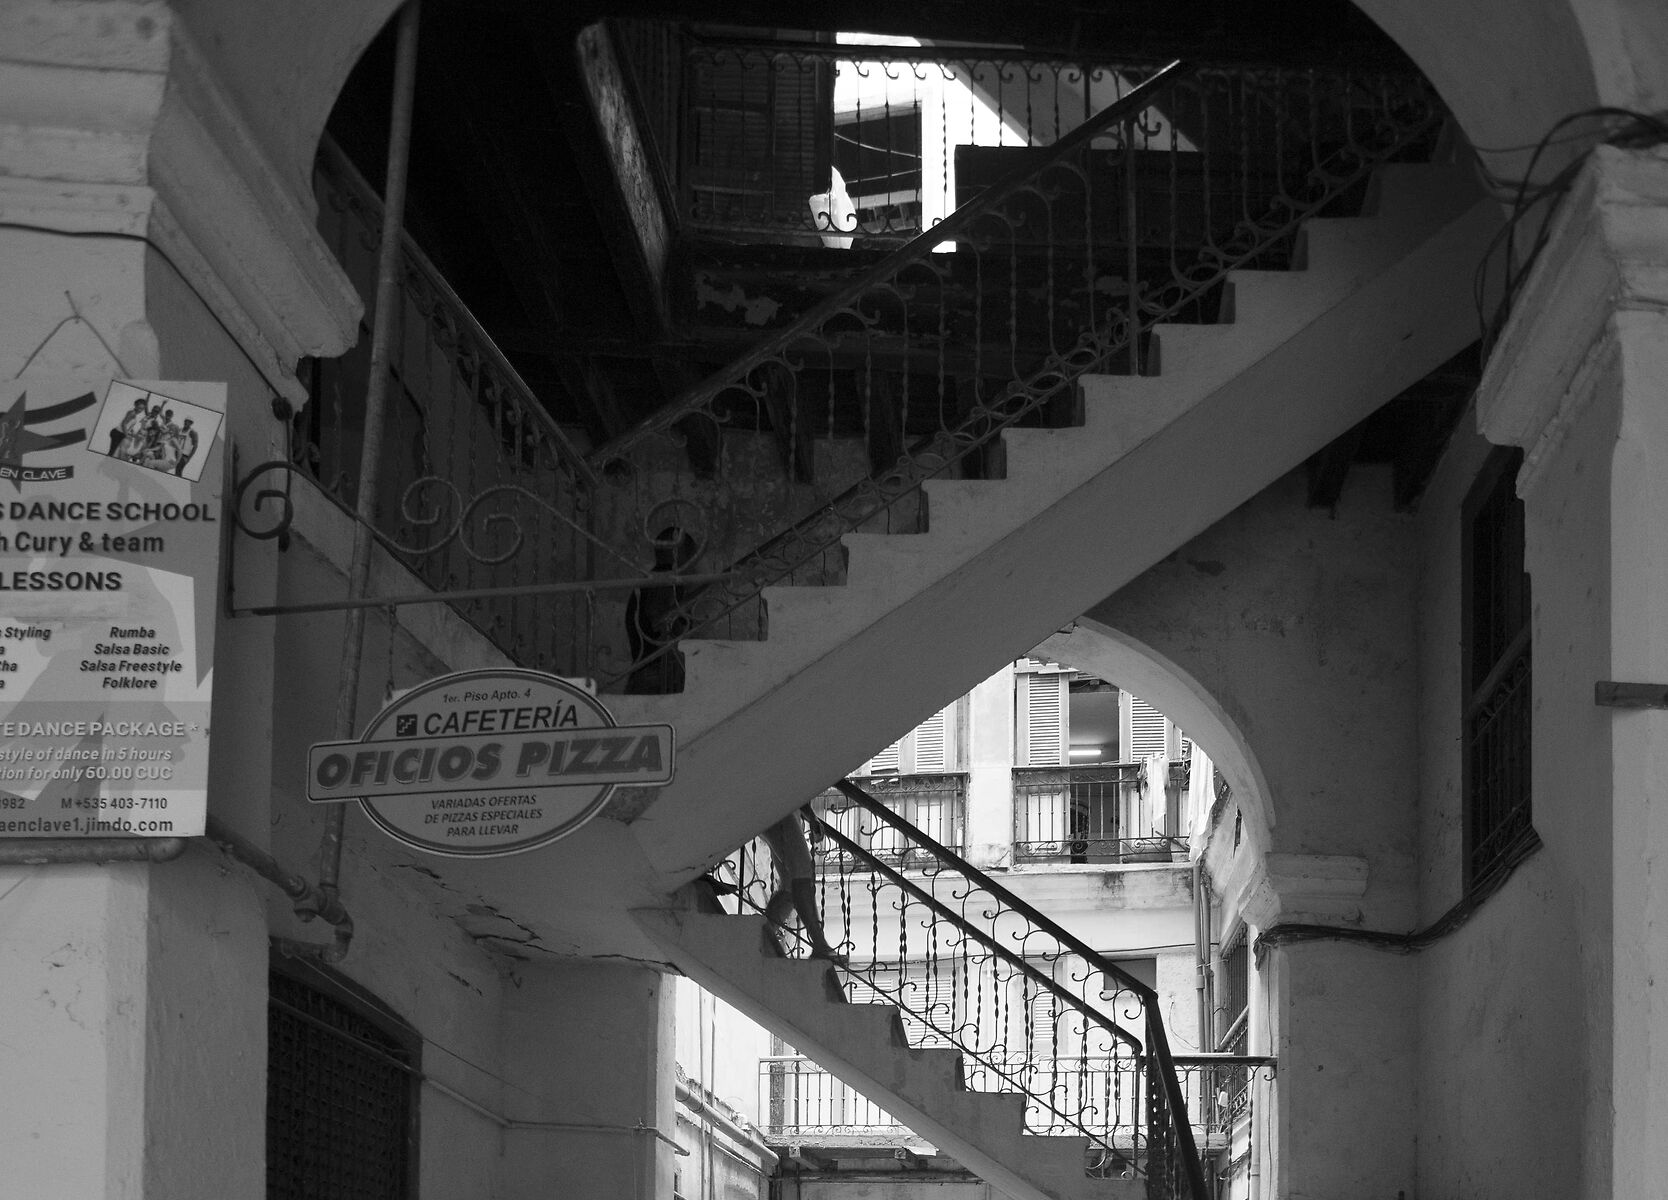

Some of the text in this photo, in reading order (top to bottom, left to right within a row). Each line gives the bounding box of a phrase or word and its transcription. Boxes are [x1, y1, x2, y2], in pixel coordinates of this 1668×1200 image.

[1, 467, 67, 480] EN CLAVE
[10, 502, 101, 521] DANCE
[106, 502, 216, 522] SCHOOL
[15, 531, 73, 557] Cury
[79, 531, 95, 552] &
[102, 533, 164, 552] team
[0, 572, 123, 591] LESSONS
[4, 626, 52, 641] Styling
[109, 626, 156, 639] Rumba
[94, 643, 170, 655] Salsa Basic
[79, 660, 183, 673] Salsa Freestyle
[102, 677, 158, 689] Folklore
[443, 688, 532, 704] 1er. Piso Apto. 4
[423, 700, 579, 735] CAFETERÍA
[18, 722, 87, 737] DANCE
[89, 722, 186, 737] PACKAGE
[36, 747, 55, 761] of
[55, 747, 99, 761] dance
[102, 748, 117, 761] in
[118, 748, 128, 761] 5
[130, 748, 172, 761] hours
[316, 735, 664, 789] OFICIOS PIZZA
[27, 766, 50, 780] for
[52, 766, 84, 782] only
[85, 767, 132, 780] 60.00
[135, 767, 173, 780] CUC
[61, 798, 168, 809] M +535 403-7110
[431, 795, 537, 809] VARIADAS OFERTAS
[424, 809, 543, 824] DE PIZZAS ESPECIALES
[447, 824, 519, 837] PARA LLEVAR
